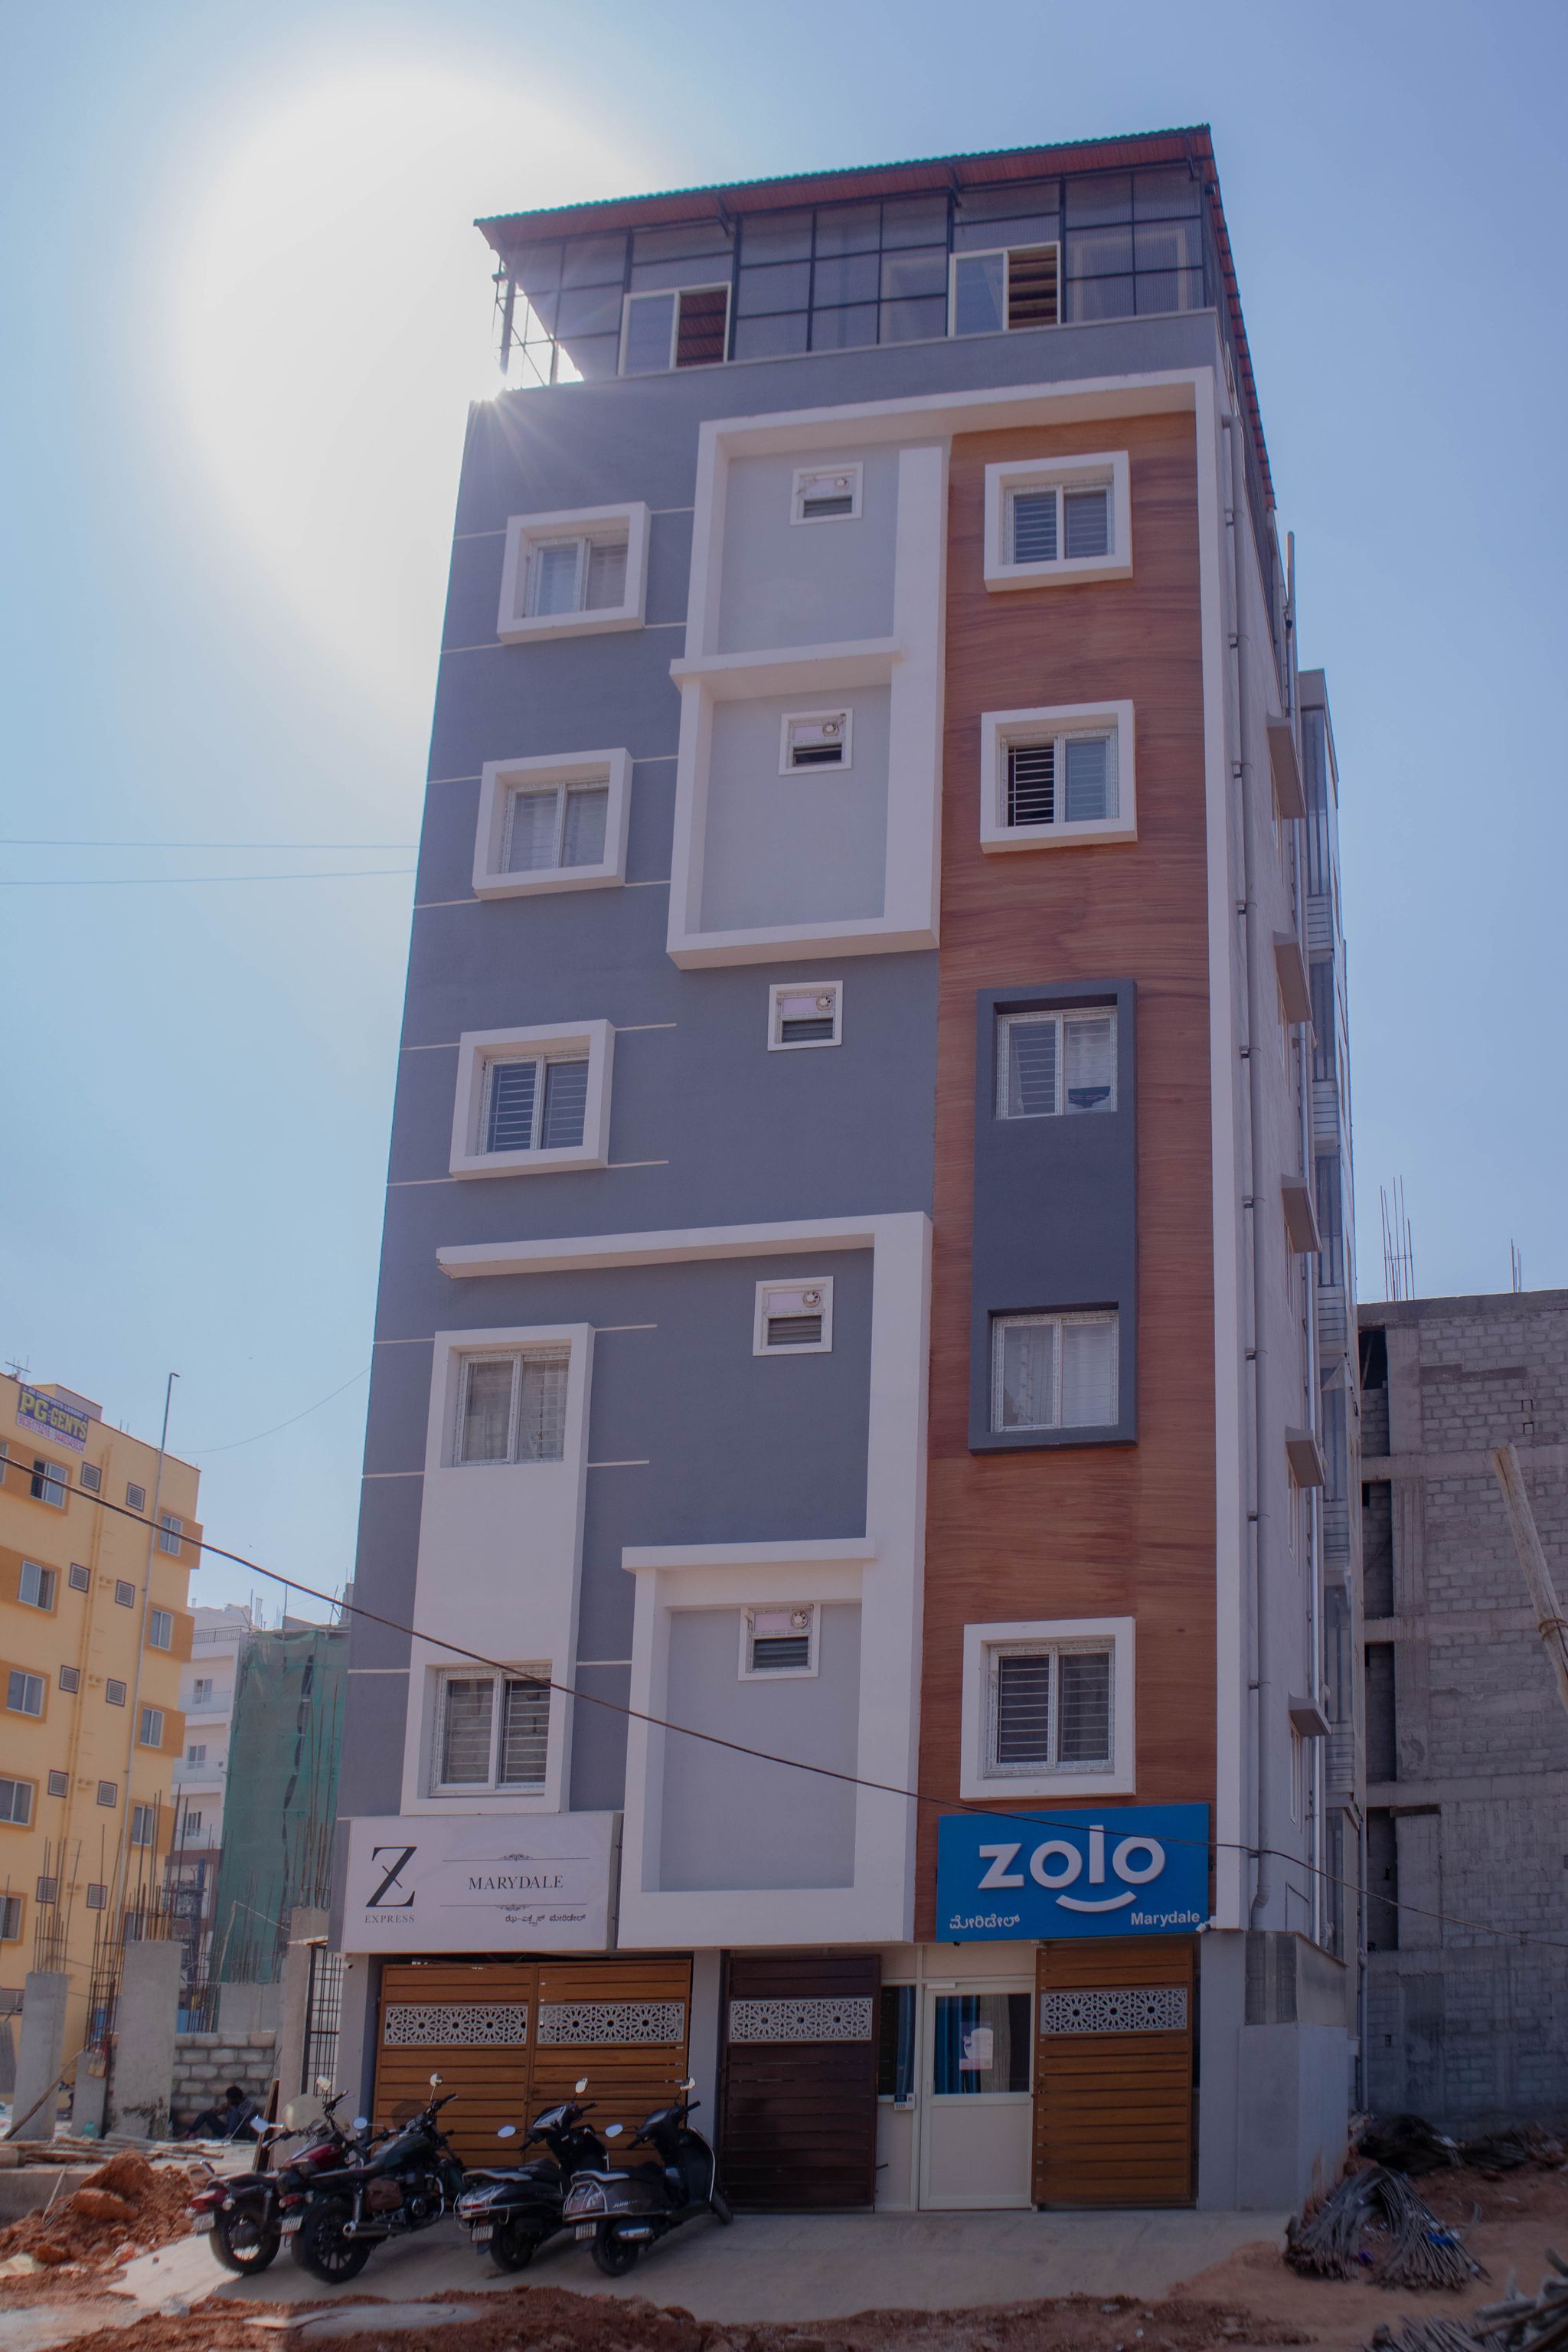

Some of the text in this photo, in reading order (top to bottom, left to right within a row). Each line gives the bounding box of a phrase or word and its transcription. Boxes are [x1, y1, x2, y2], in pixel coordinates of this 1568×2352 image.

[19, 1390, 49, 1423] PG
[51, 1407, 87, 1441] GENTS
[978, 1824, 1166, 1889] zolo
[469, 1875, 564, 1890] MARYDALE
[364, 1914, 415, 1924] EXPRESS
[949, 1913, 1021, 1929] ಮೇರಿಡೇಲ್
[1131, 1910, 1200, 1927] Marydale
